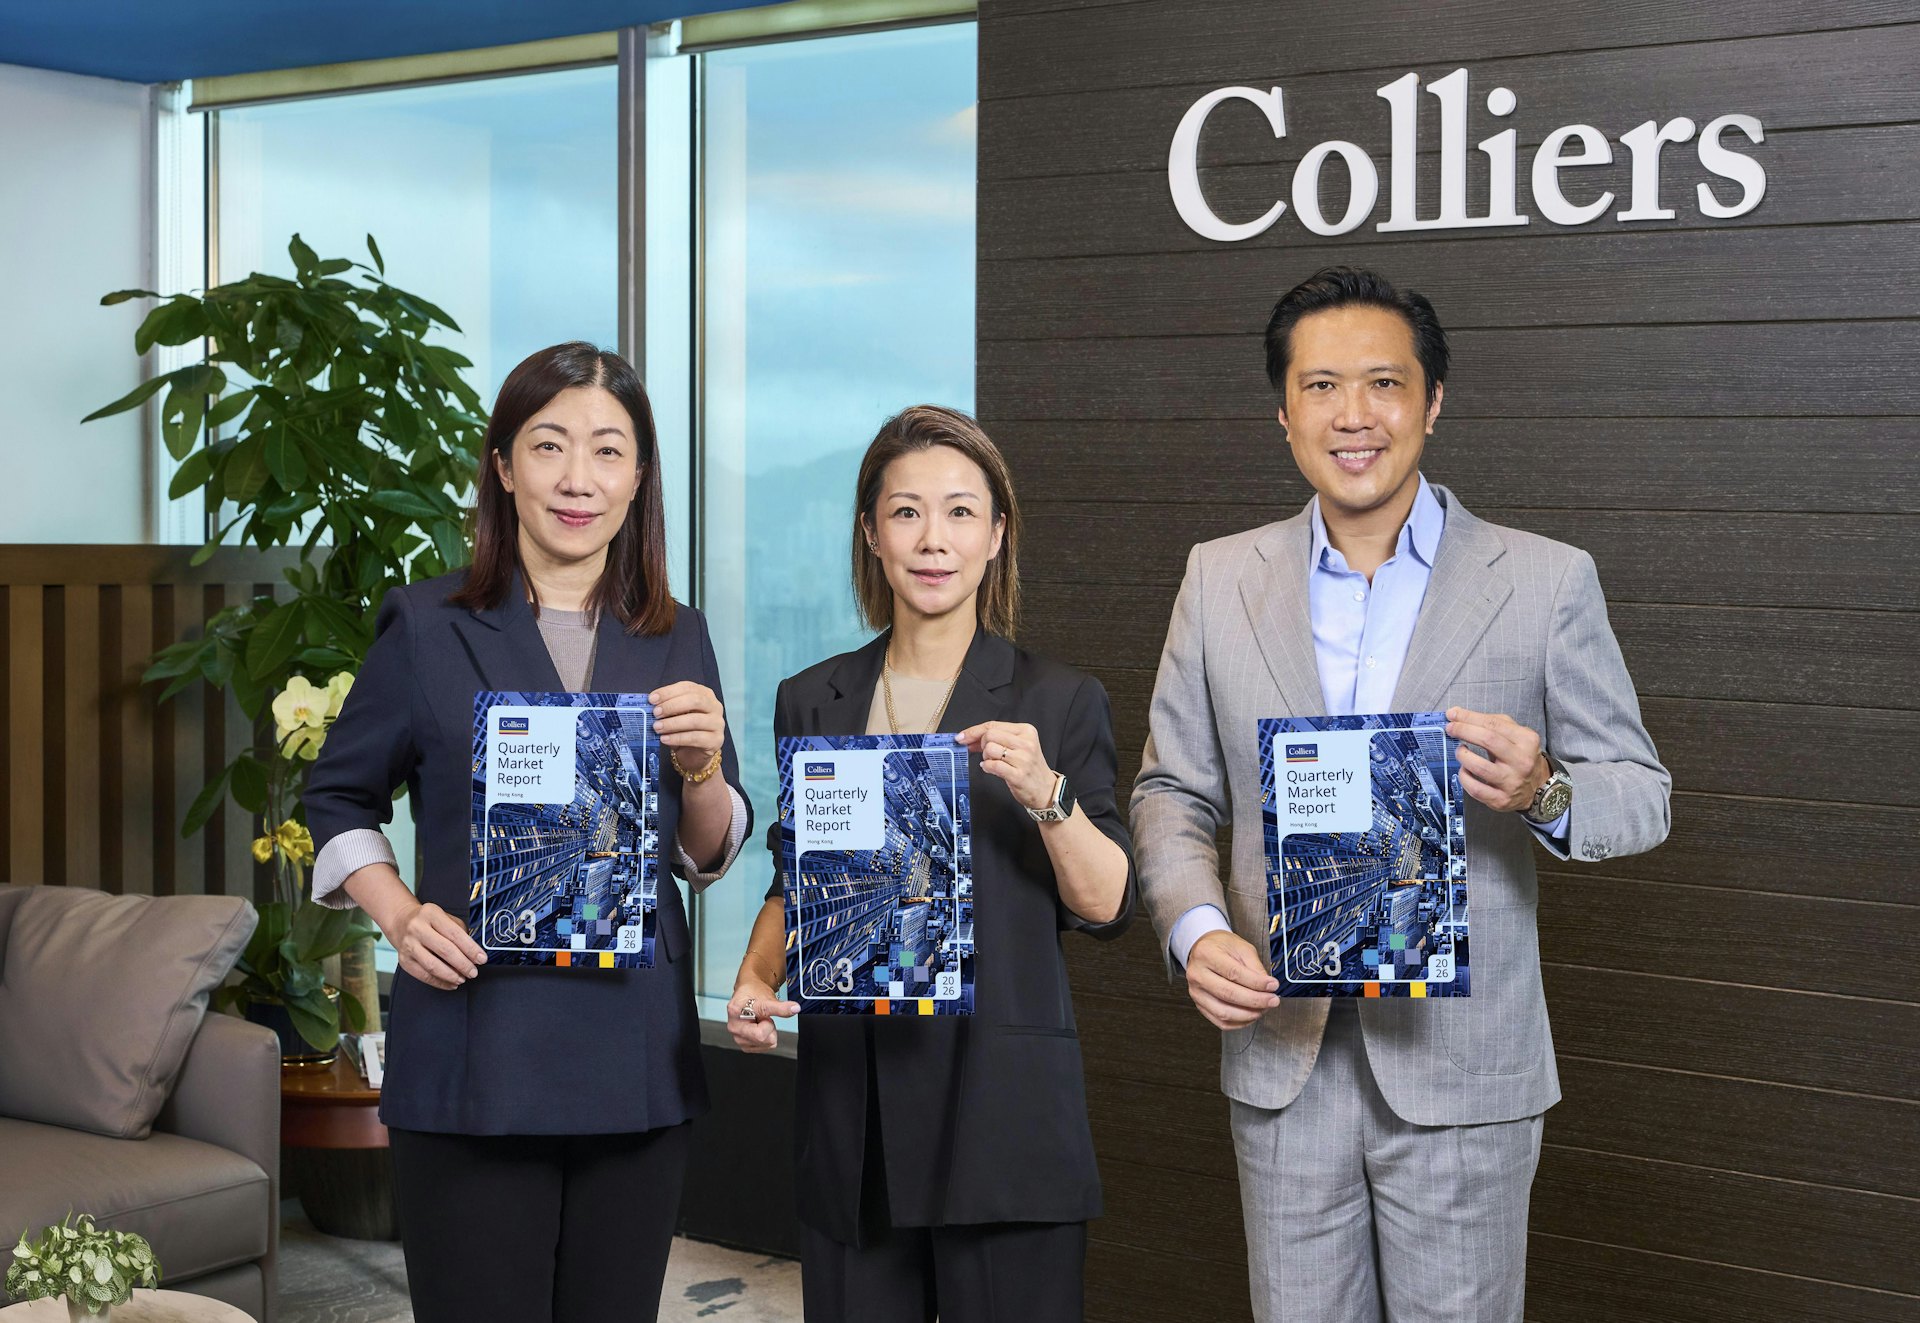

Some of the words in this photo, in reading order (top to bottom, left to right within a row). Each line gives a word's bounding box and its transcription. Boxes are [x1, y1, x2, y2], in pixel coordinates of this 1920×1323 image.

[1168, 68, 1767, 242] Colliers
[501, 720, 527, 729] Colliers
[498, 742, 560, 757] Quarterly
[1288, 747, 1316, 756] Colliers
[498, 757, 543, 769] Market
[807, 766, 833, 774] Colliers
[1286, 768, 1353, 783] Quarterly
[497, 773, 541, 787] Report
[805, 787, 867, 802] Quarterly
[1288, 785, 1336, 798] Market
[806, 803, 851, 815] Market
[1288, 802, 1335, 816] Report
[806, 819, 850, 833] Report
[624, 930, 636, 939] 20
[624, 940, 636, 949] 26
[1435, 959, 1448, 968] 20
[1436, 969, 1449, 978] 26
[942, 976, 955, 985] 20
[942, 986, 955, 996] 26
